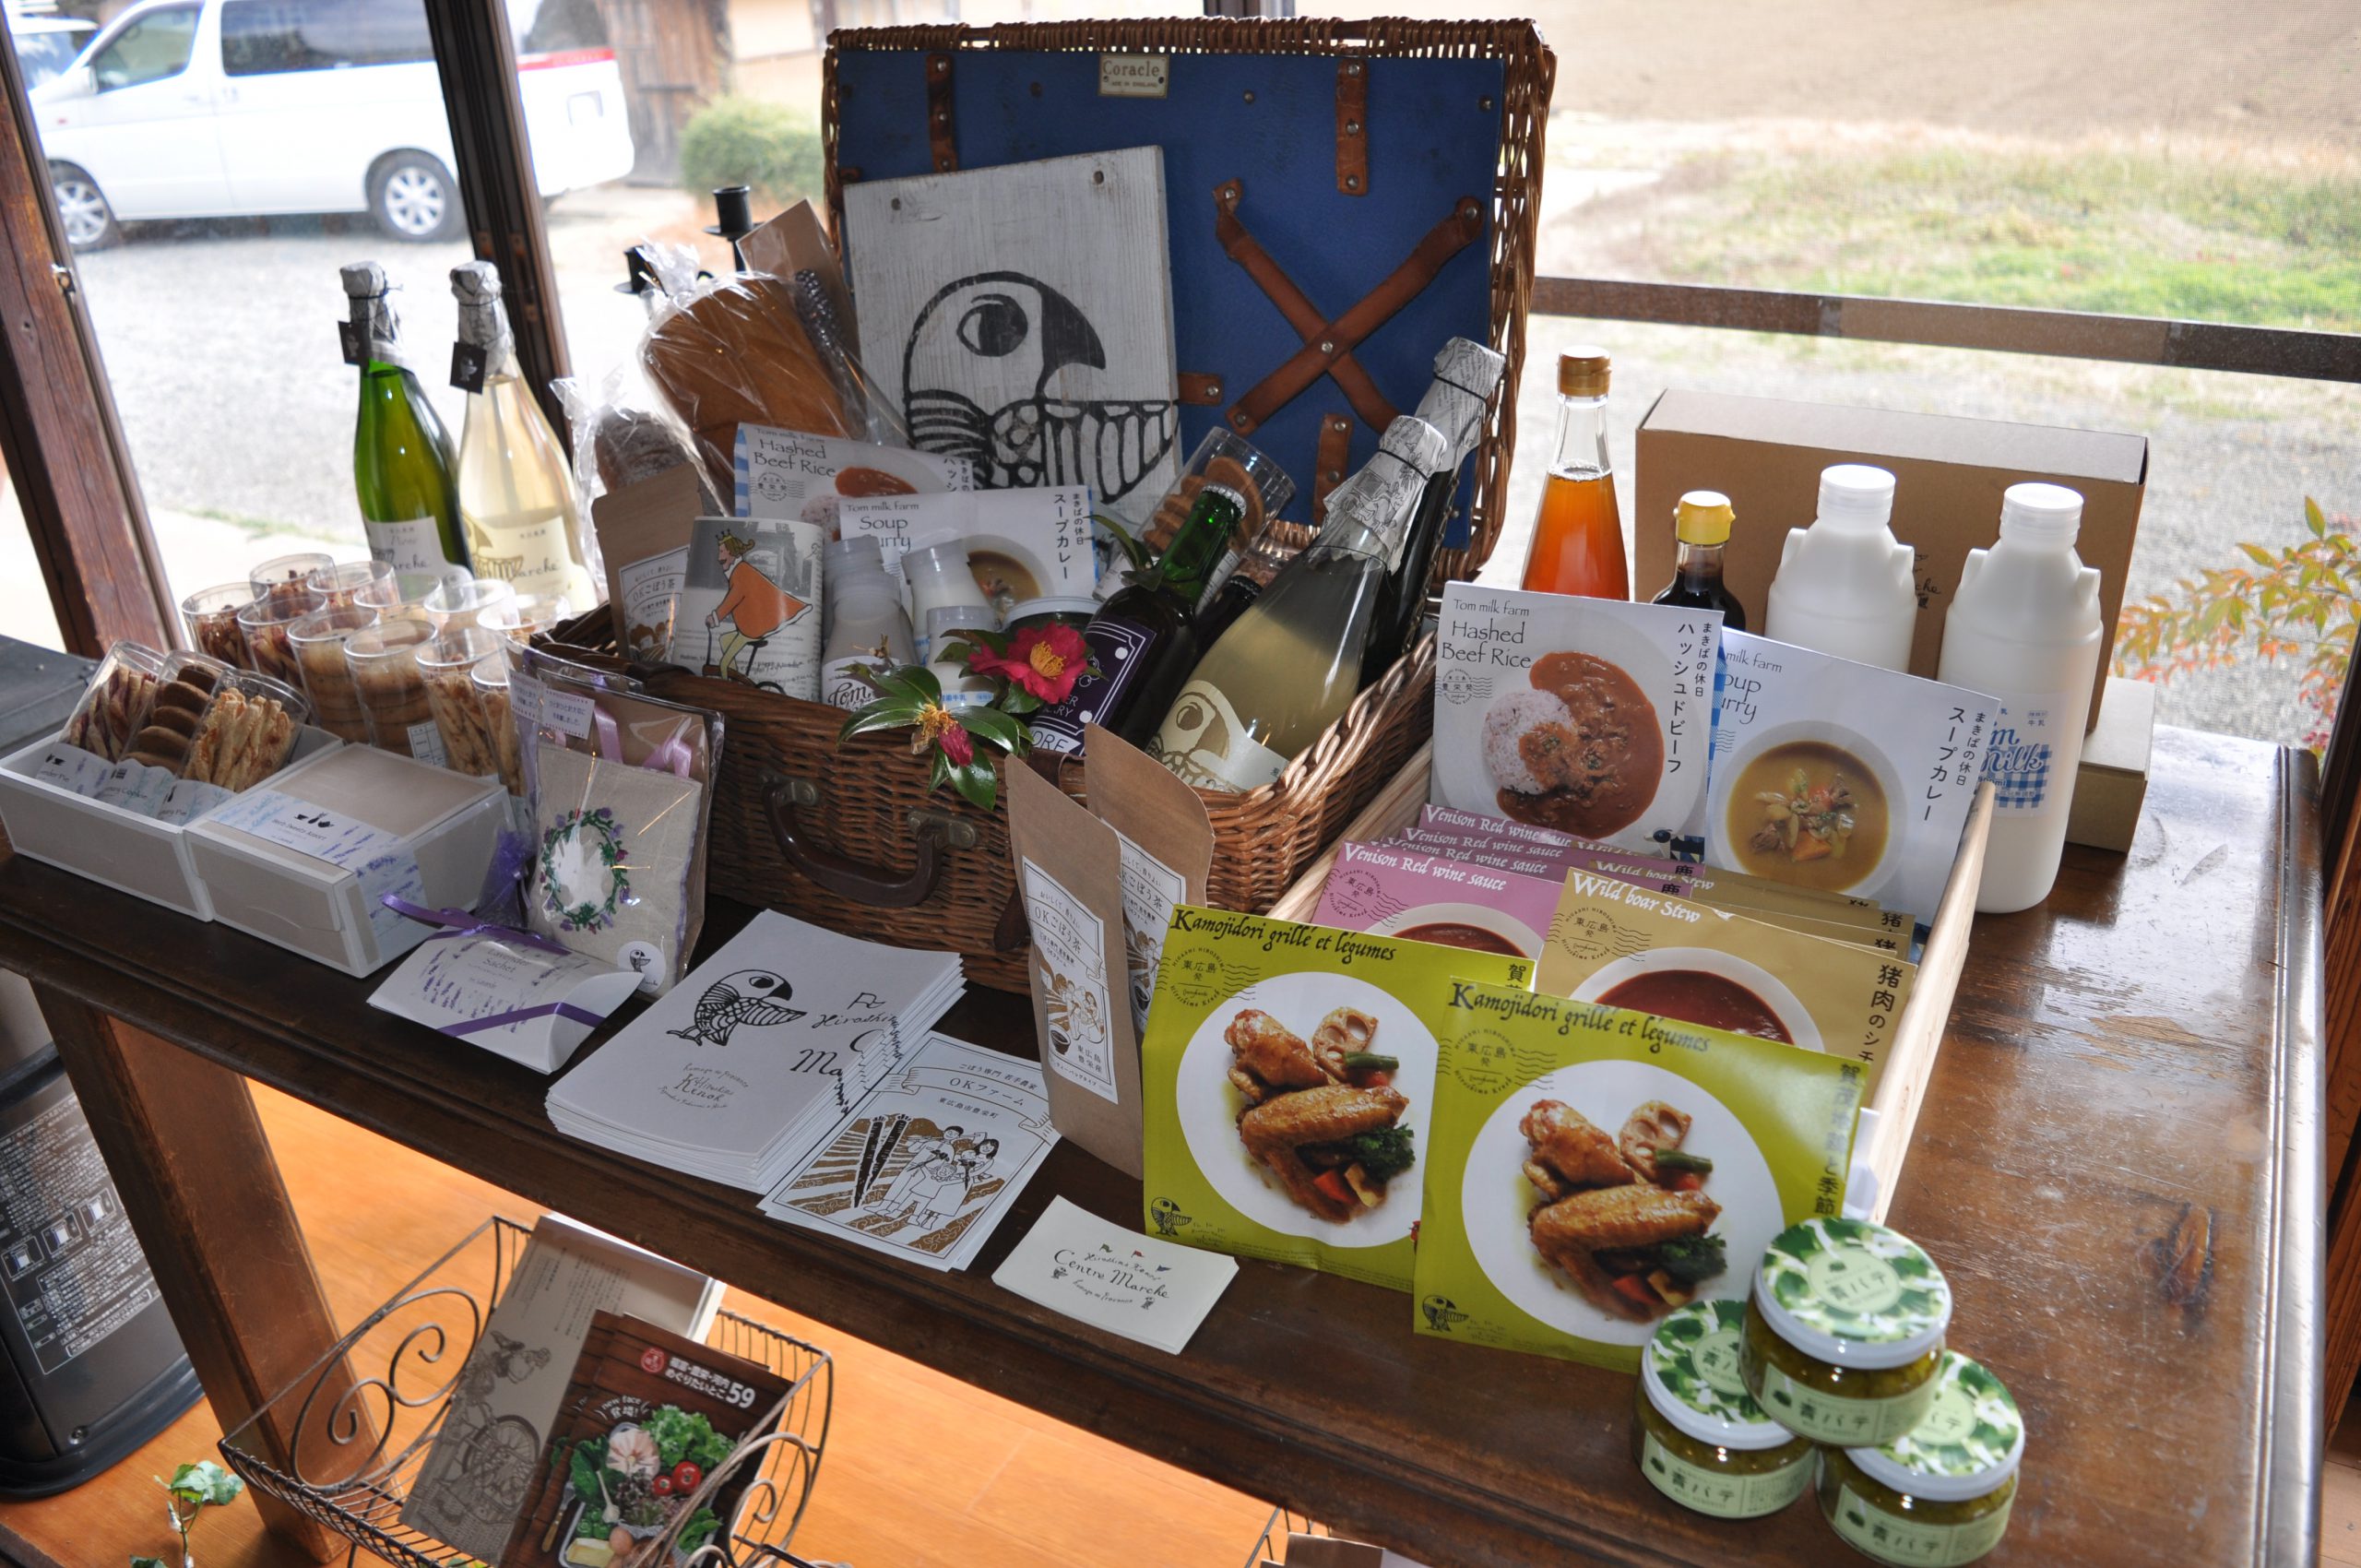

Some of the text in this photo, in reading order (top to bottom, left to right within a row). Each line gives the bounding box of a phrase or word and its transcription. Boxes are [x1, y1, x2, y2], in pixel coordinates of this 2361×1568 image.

[1103, 60, 1159, 77] Coracle
[760, 438, 826, 459] Hashed
[753, 451, 836, 478] Beef Rice
[847, 501, 919, 512] Tom milk farm
[859, 516, 908, 539] Soup
[1453, 599, 1530, 616] Tom milk farm
[1452, 618, 1525, 644] Hashed
[1442, 641, 1531, 668] Beef Rice
[1695, 623, 1712, 697] まきばの休日
[1726, 649, 1783, 673] milk farm
[1667, 624, 1694, 773] ハッシュドビーフ
[1725, 674, 1762, 703] oup
[1956, 712, 1986, 786] まきばの休日
[1924, 707, 1964, 821] スープカレー
[1423, 803, 1476, 828] Venison
[1479, 817, 1508, 834] Red
[1509, 825, 1539, 841] wine
[1405, 827, 1563, 859] Venison Red wine sauce
[1344, 842, 1508, 891] Venison Red wine sauce
[1445, 847, 1473, 861] Red
[1475, 852, 1509, 868] wine
[1510, 861, 1548, 874] sauce
[1596, 860, 1642, 876] Wild
[1121, 870, 1164, 910] Kごぼう茶
[1346, 877, 1374, 897] 東広島
[1572, 872, 1701, 922] Wild boar Stew
[1035, 906, 1082, 954] OKごぼう茶
[1169, 909, 1396, 964] Kamojidori grillé et légumes
[1573, 918, 1609, 932] 東広島
[1181, 960, 1216, 973] 東広島
[1448, 982, 1711, 1053] Kamojidori grillé et légumes
[1858, 965, 1904, 1062] 猪肉のシチ
[1465, 1042, 1506, 1059] 東広島
[959, 1063, 1003, 1077] ごぼう専門
[950, 1077, 1024, 1106] OKファーム
[940, 1098, 1000, 1119] 東広島市豊栄町
[1053, 1249, 1105, 1280] Centre
[1109, 1269, 1170, 1299] Marche
[665, 1369, 755, 1408] めぐりたいとこ 59
